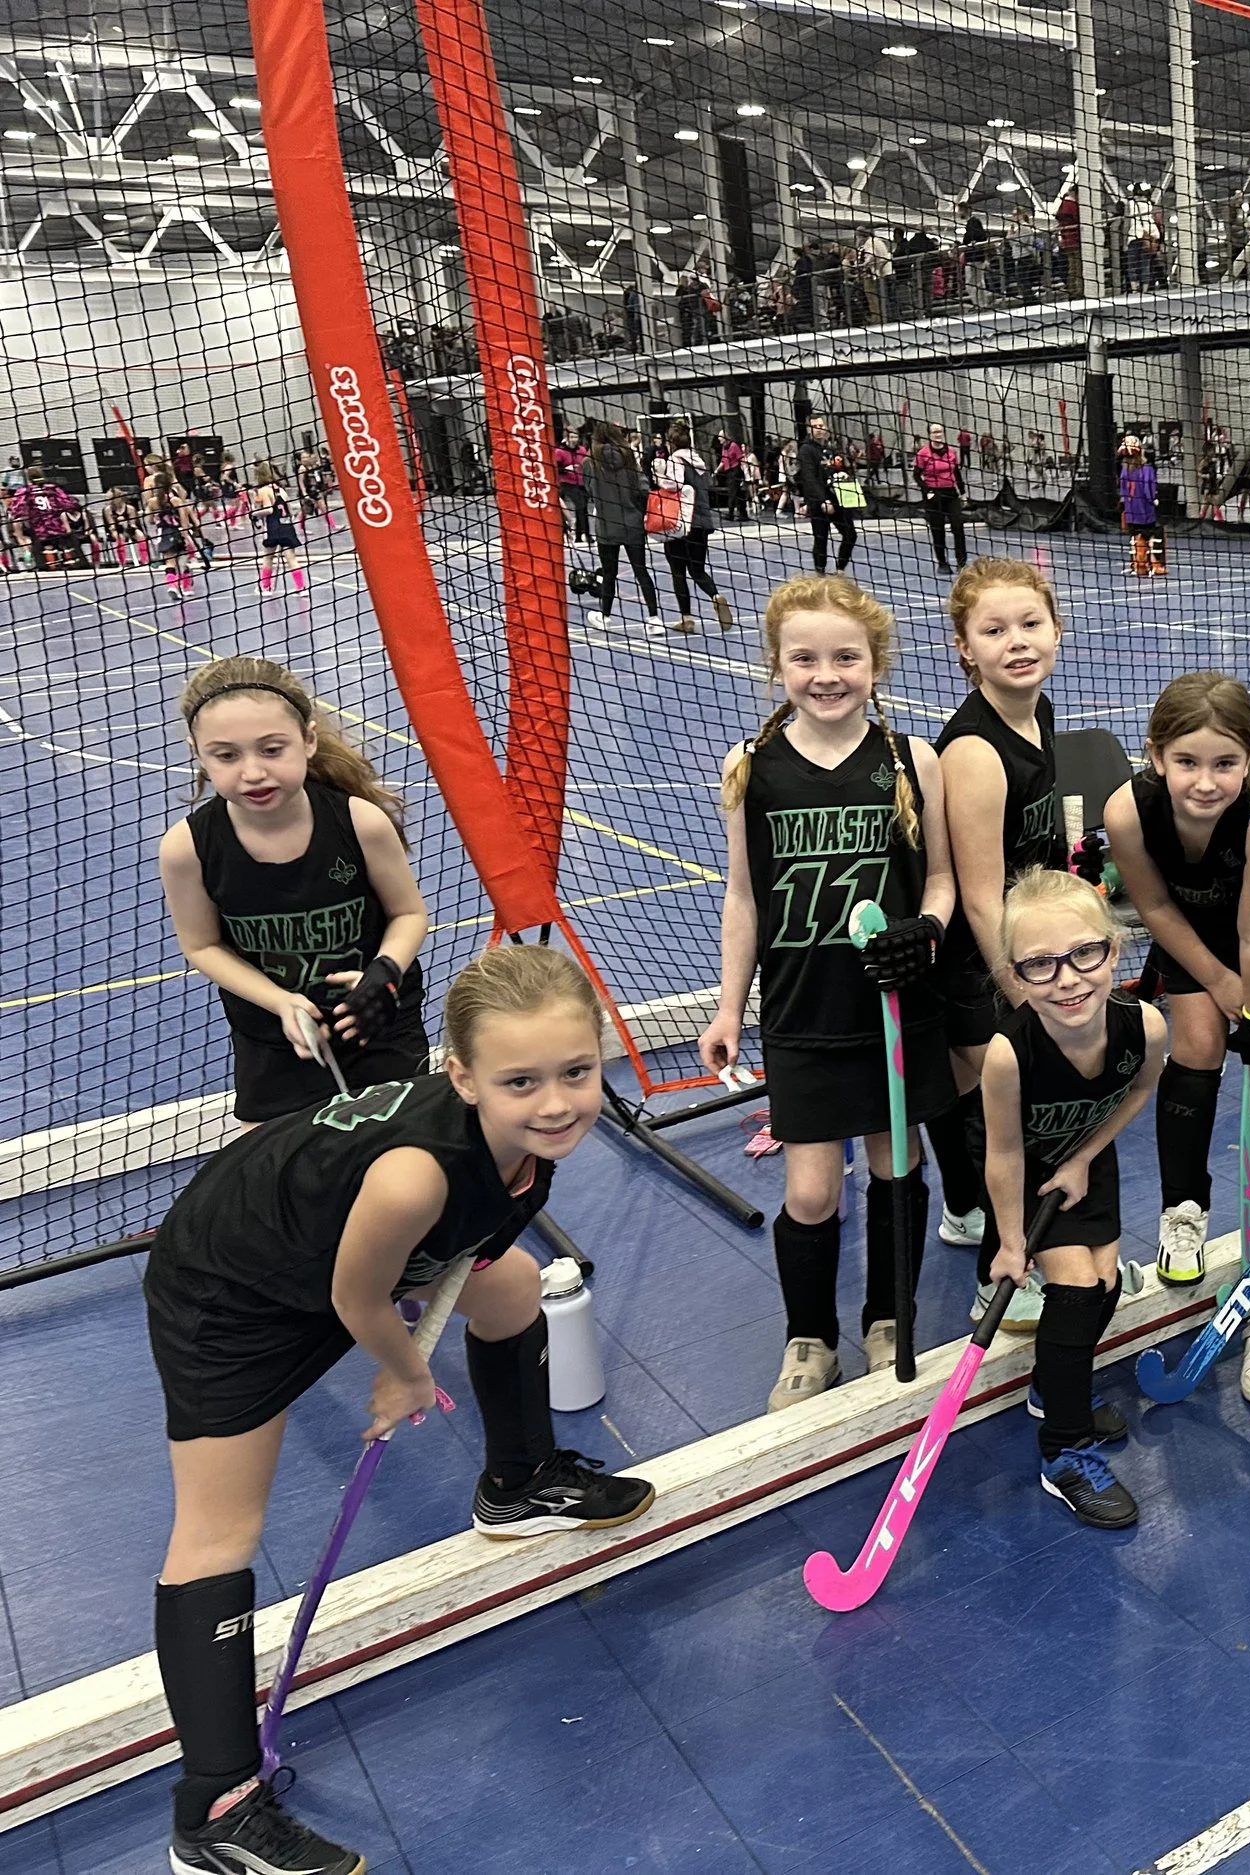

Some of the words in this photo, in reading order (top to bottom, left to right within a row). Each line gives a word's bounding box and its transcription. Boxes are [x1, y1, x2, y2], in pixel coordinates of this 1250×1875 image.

[329, 366, 393, 528] GoSports
[766, 805, 897, 859] DYNASTY
[220, 895, 366, 953] DYNASTY
[769, 856, 891, 949] 11
[864, 1420, 948, 1570] TK
